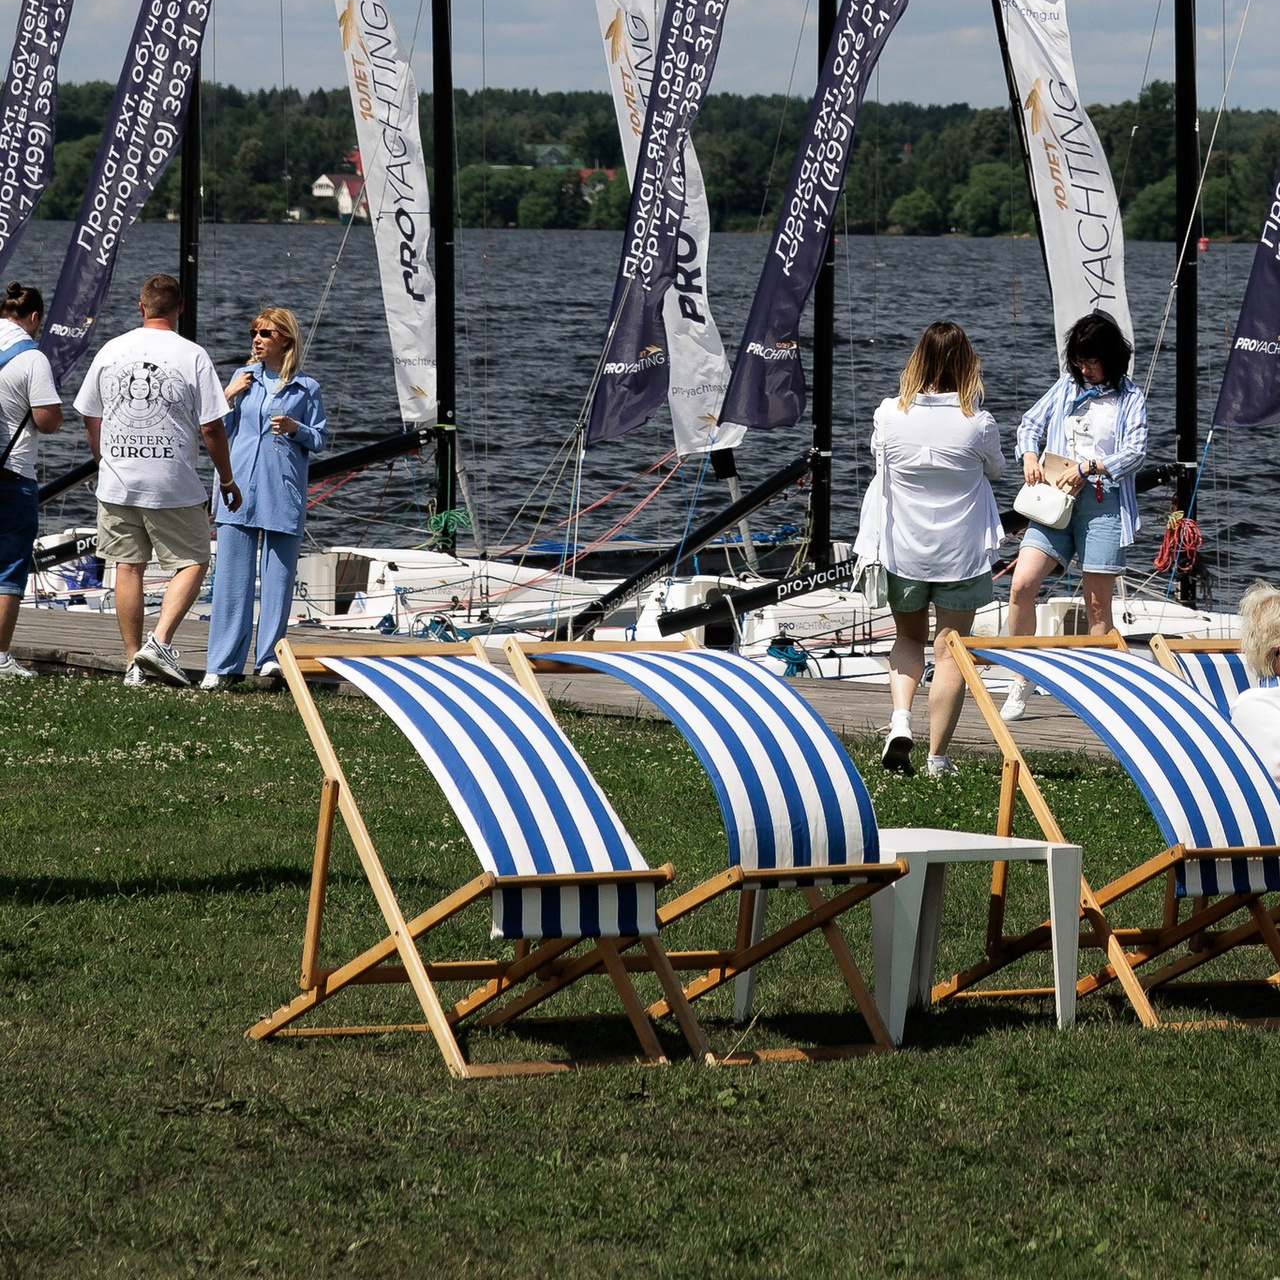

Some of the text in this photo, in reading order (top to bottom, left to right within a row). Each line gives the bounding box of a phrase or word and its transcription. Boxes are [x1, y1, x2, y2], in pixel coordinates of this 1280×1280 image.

[162, 59, 192, 117] 393
[178, 23, 201, 58] 31
[695, 23, 718, 57] 31
[23, 120, 51, 191] (499)
[77, 144, 121, 251] Прокат
[115, 92, 140, 142] яхт,
[97, 42, 170, 267] корпоративные
[360, 0, 427, 303] PROYACHTING
[641, 50, 690, 292] корпоративные
[775, 144, 815, 261] Прокат
[814, 87, 838, 139] яхт,
[820, 112, 855, 192] (499)
[622, 168, 656, 279] Прокат
[813, 193, 829, 233] +7
[1049, 79, 1118, 312] YACHTING
[110, 434, 174, 446] MYSTERY
[110, 445, 174, 459] CIRCLE
[603, 563, 670, 619] pro-yachting.ru
[778, 619, 831, 631] PROYACHTING
